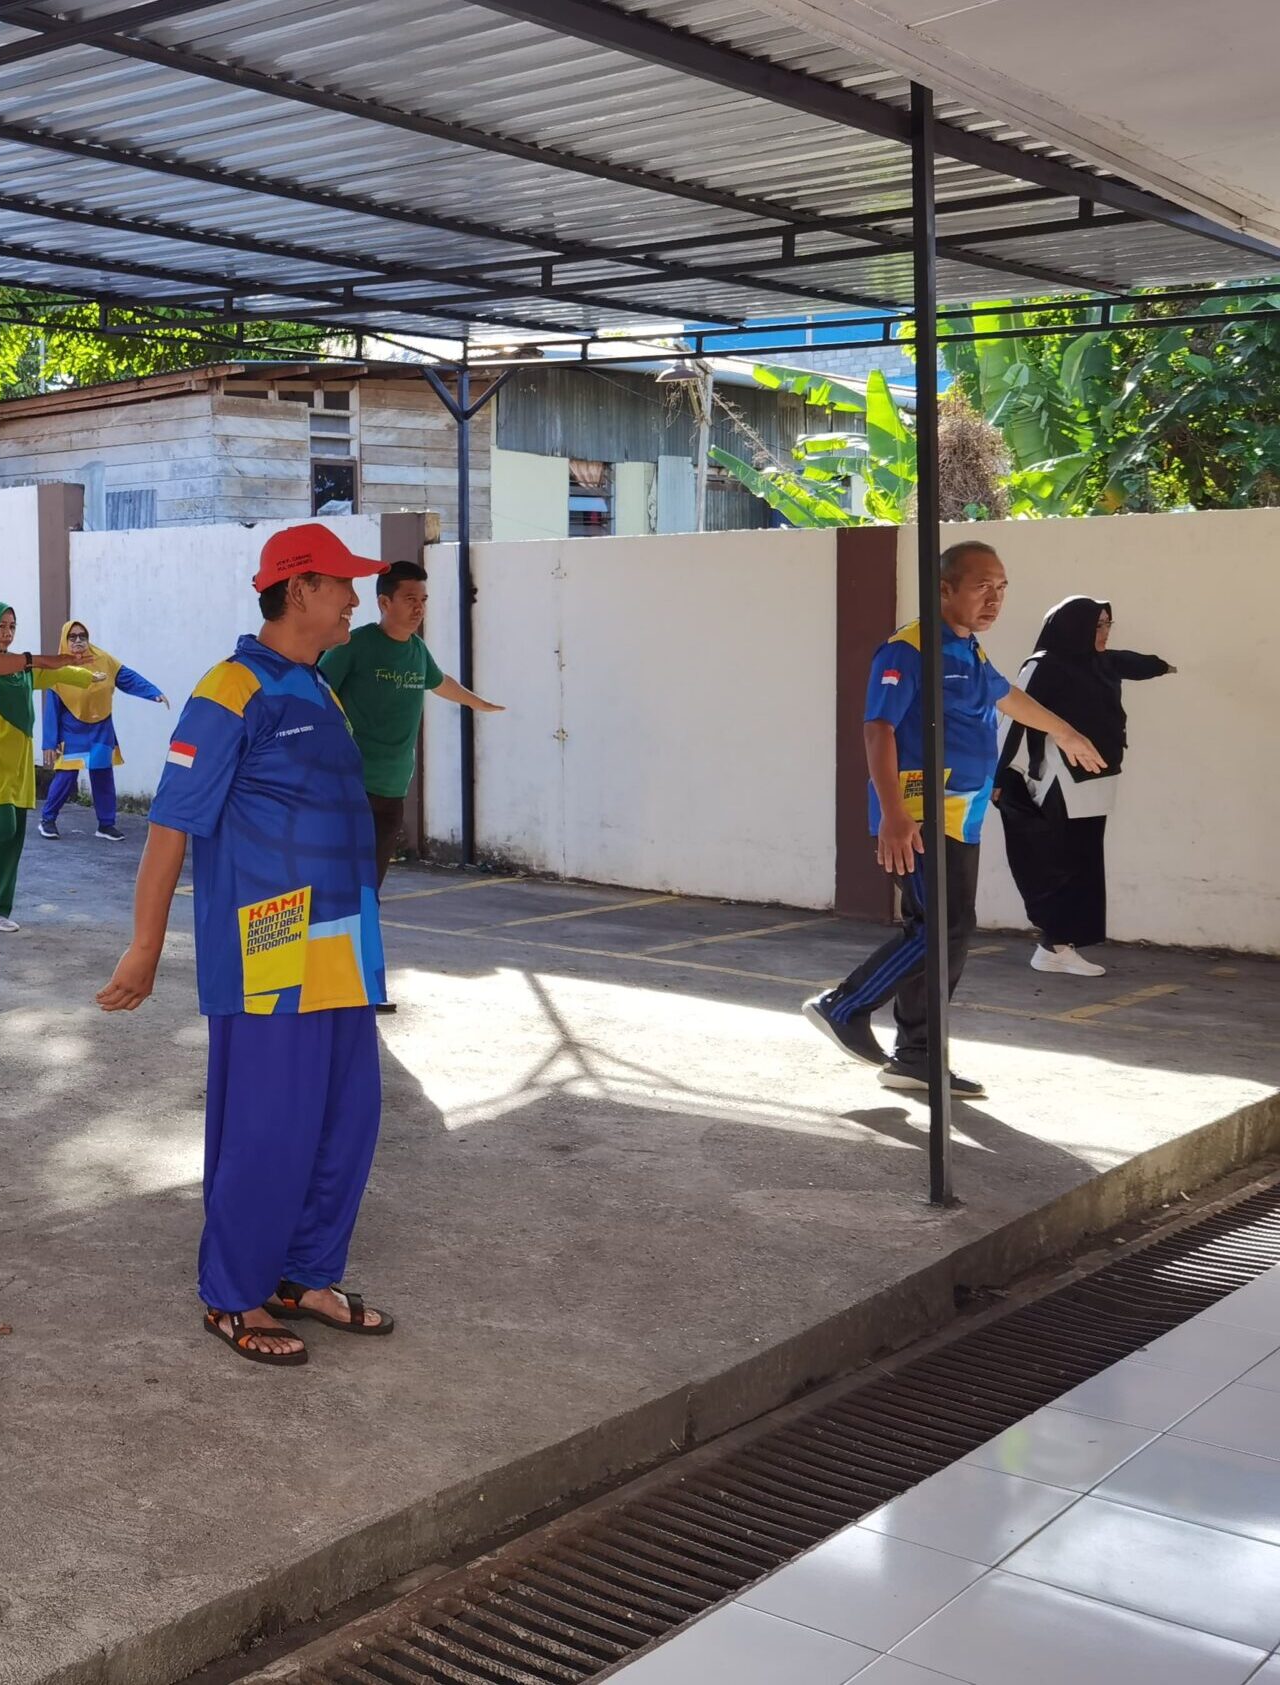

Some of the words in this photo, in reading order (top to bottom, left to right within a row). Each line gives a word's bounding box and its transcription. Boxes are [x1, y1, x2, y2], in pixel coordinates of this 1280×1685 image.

[249, 892, 305, 920] KAMI
[249, 905, 304, 929] KOMITMEN
[247, 927, 290, 947] MODERN
[248, 914, 304, 938] AKUNTABEL
[246, 931, 302, 956] ISTIQAMAH
